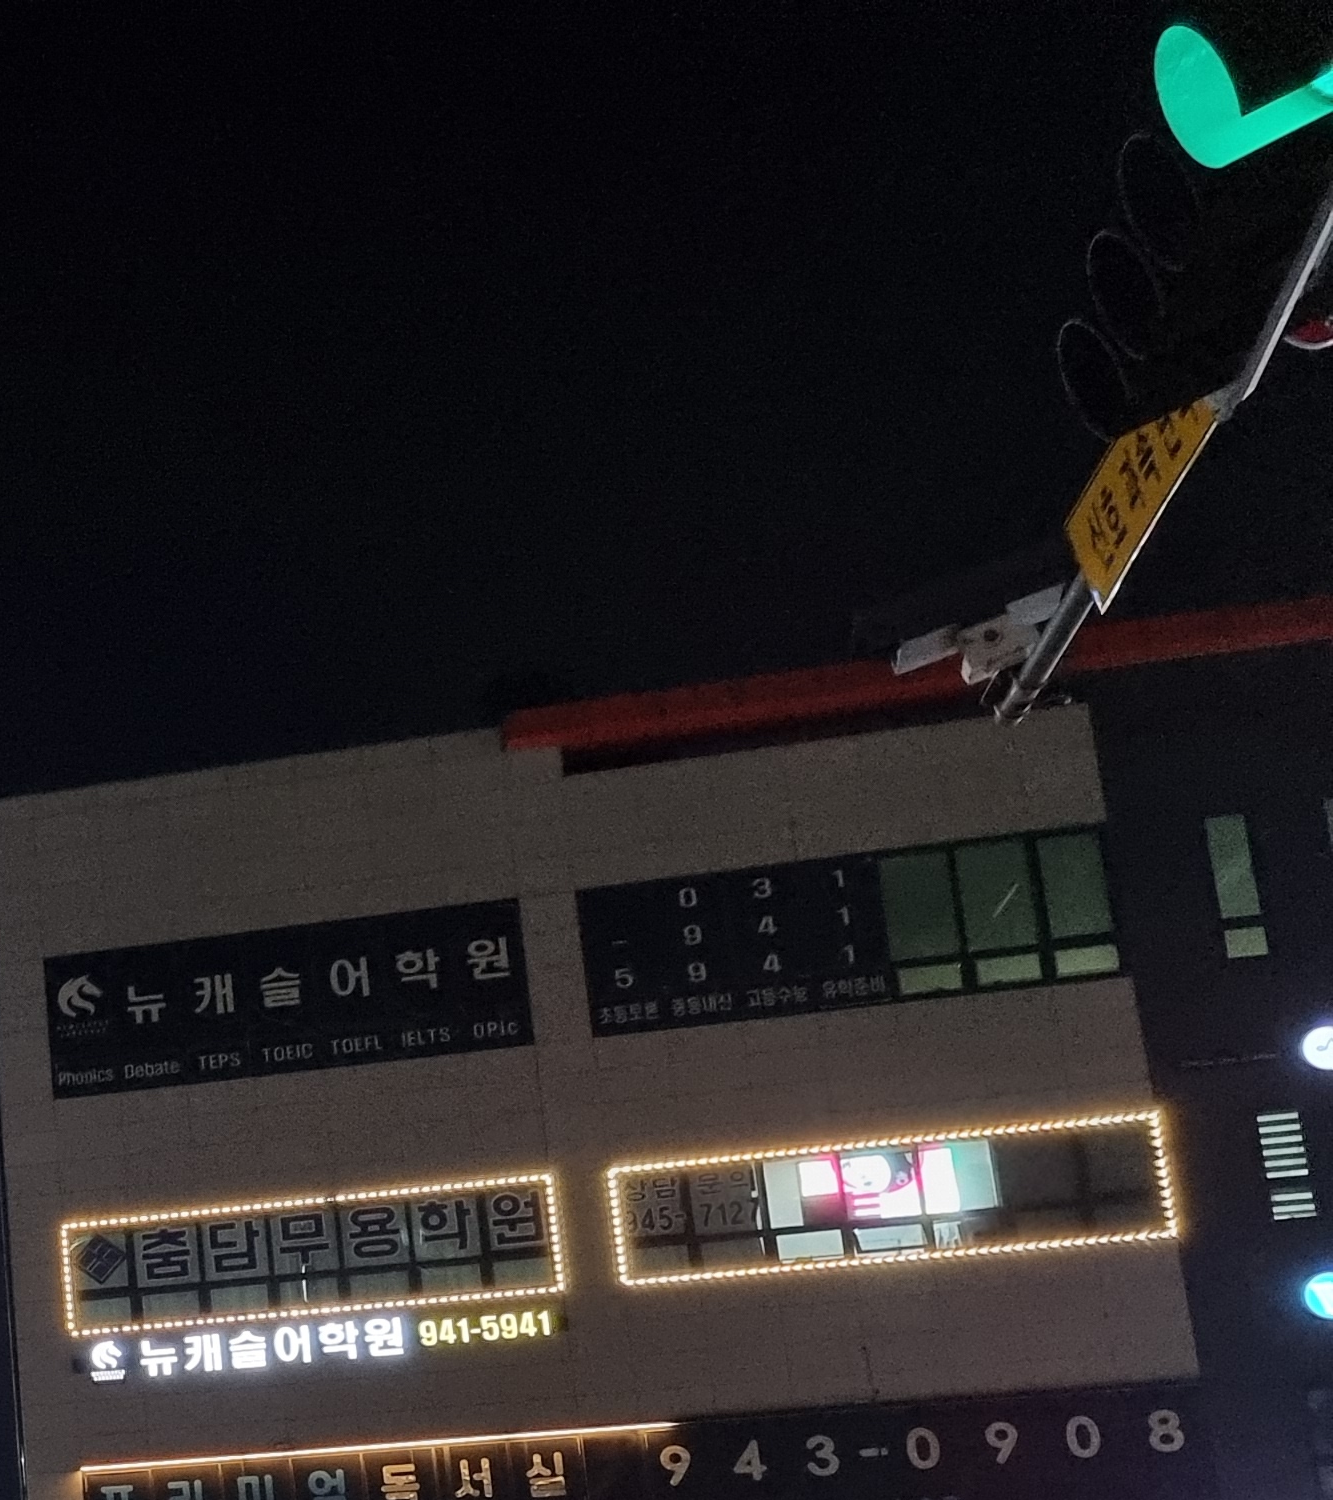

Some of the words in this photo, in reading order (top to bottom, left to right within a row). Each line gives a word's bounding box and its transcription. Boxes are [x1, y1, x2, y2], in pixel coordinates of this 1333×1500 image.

[126, 937, 511, 1024] 뉴캐슬어학원
[58, 1066, 113, 1086] Phonics
[124, 1058, 180, 1079] Debate
[199, 1051, 241, 1071] TEPS
[262, 1043, 313, 1063] TOEIC
[333, 1035, 383, 1055] TOEFL
[400, 1027, 451, 1048] IELTS
[142, 1190, 546, 1282] 춤담무용학원
[140, 1317, 405, 1376] 뉴캐슬어학원
[418, 1310, 553, 1347] 941-5941
[659, 1408, 1186, 1487] 943-0908
